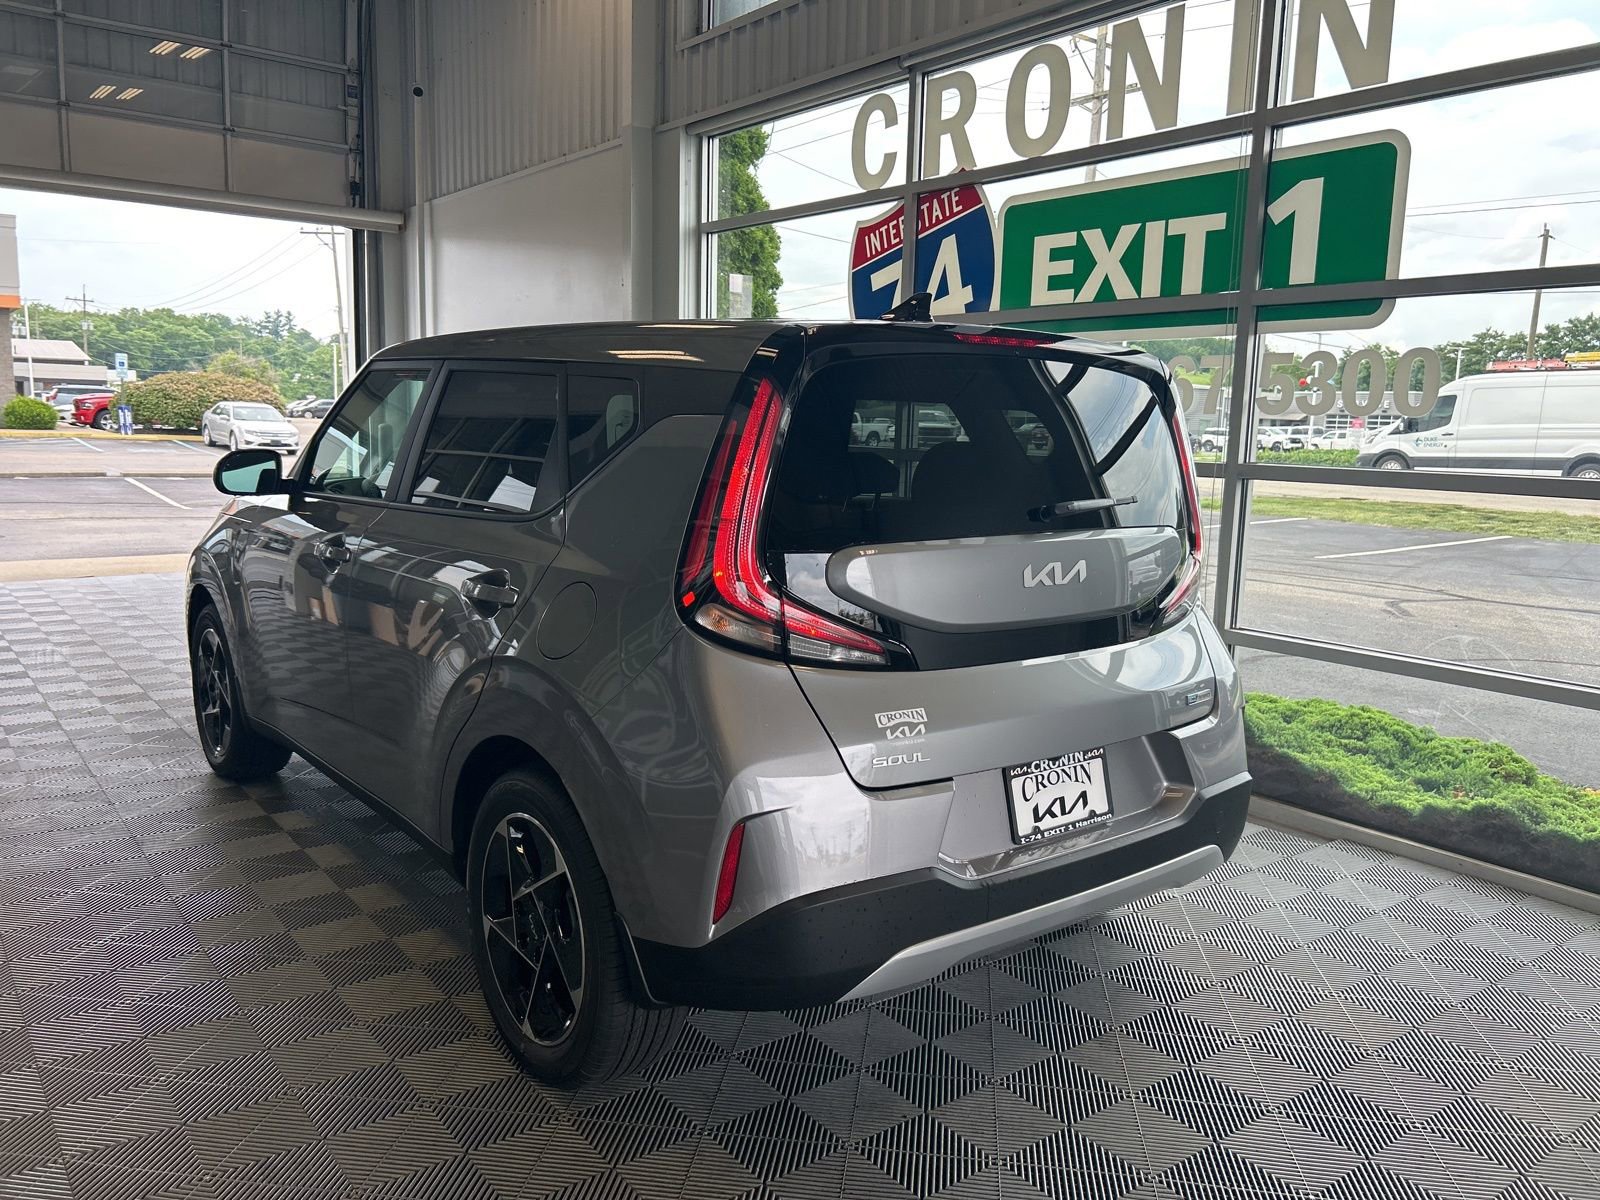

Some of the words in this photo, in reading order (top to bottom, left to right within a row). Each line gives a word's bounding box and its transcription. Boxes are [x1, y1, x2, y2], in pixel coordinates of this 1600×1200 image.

[851, 0, 1395, 191] CRONIN
[864, 187, 963, 259] INTERTATE
[1030, 212, 1227, 306] EXIT
[1267, 177, 1324, 285] 1
[1023, 560, 1087, 587] KIA
[878, 709, 925, 726] CRONIN
[886, 723, 926, 740] KIA
[872, 752, 931, 768] SOUL
[1021, 762, 1092, 803] CRONIN
[1032, 790, 1089, 824] KIA
[1020, 833, 1042, 845] I-74
[1044, 825, 1066, 838] EXIT
[1068, 823, 1074, 831] 1
[1076, 813, 1112, 828] Harrison
